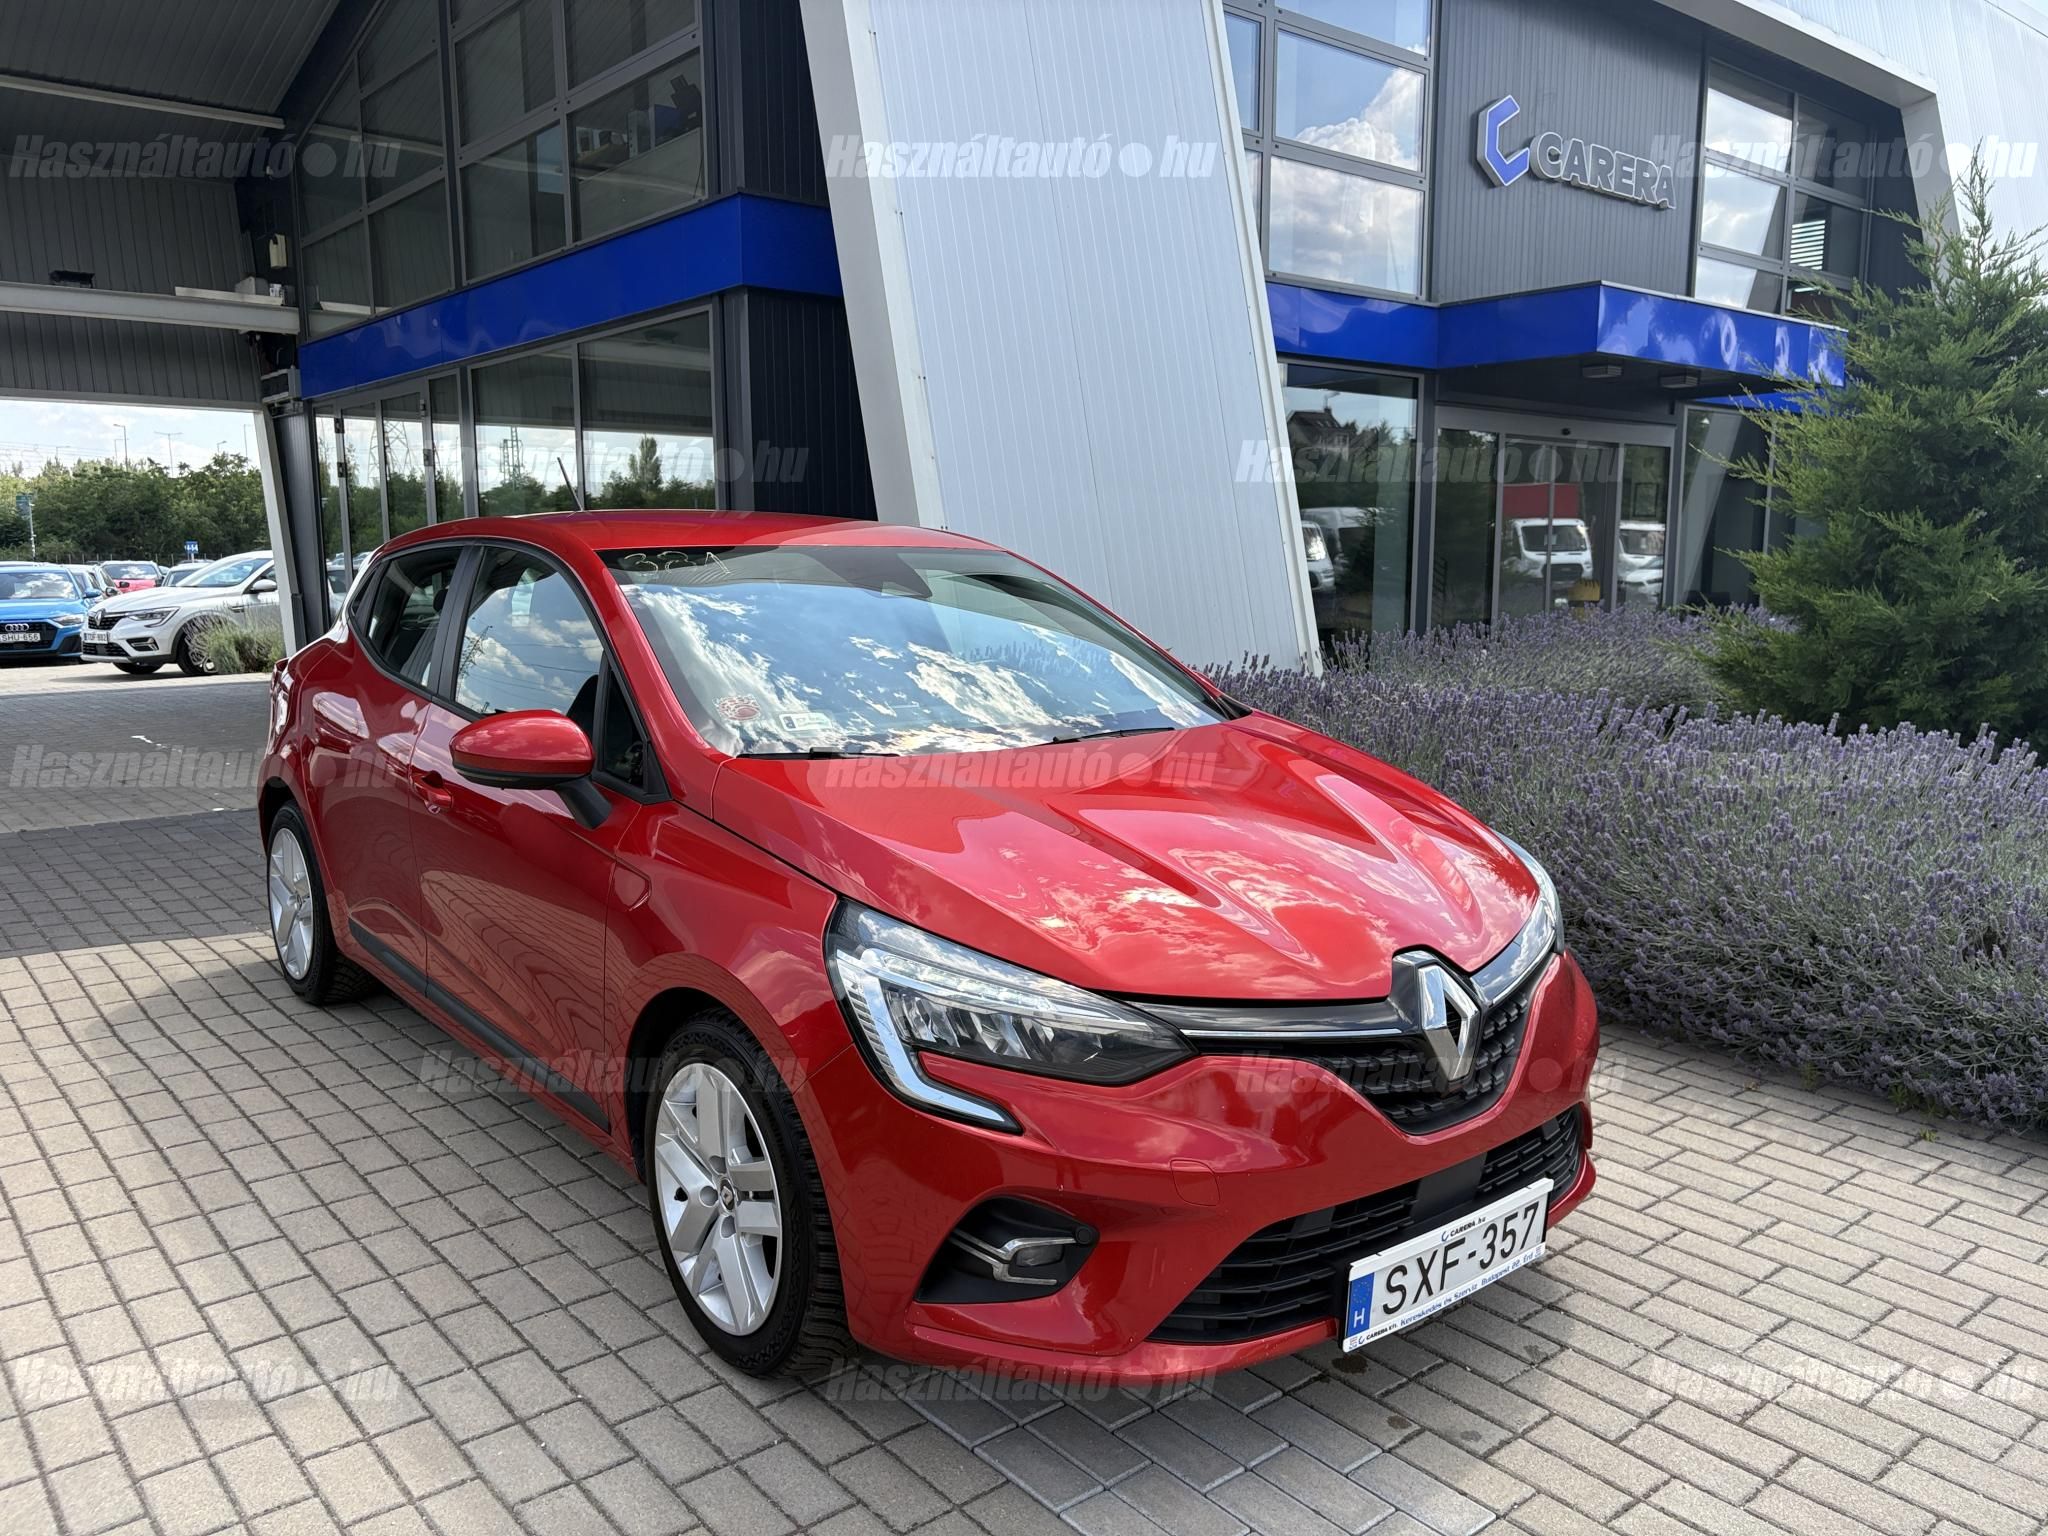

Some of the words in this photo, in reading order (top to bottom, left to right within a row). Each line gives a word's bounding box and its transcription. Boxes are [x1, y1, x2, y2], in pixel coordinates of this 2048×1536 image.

[1533, 131, 1677, 210] CARERA
[1382, 1200, 1540, 1316] SXF-357
[1353, 1307, 1366, 1329] H
